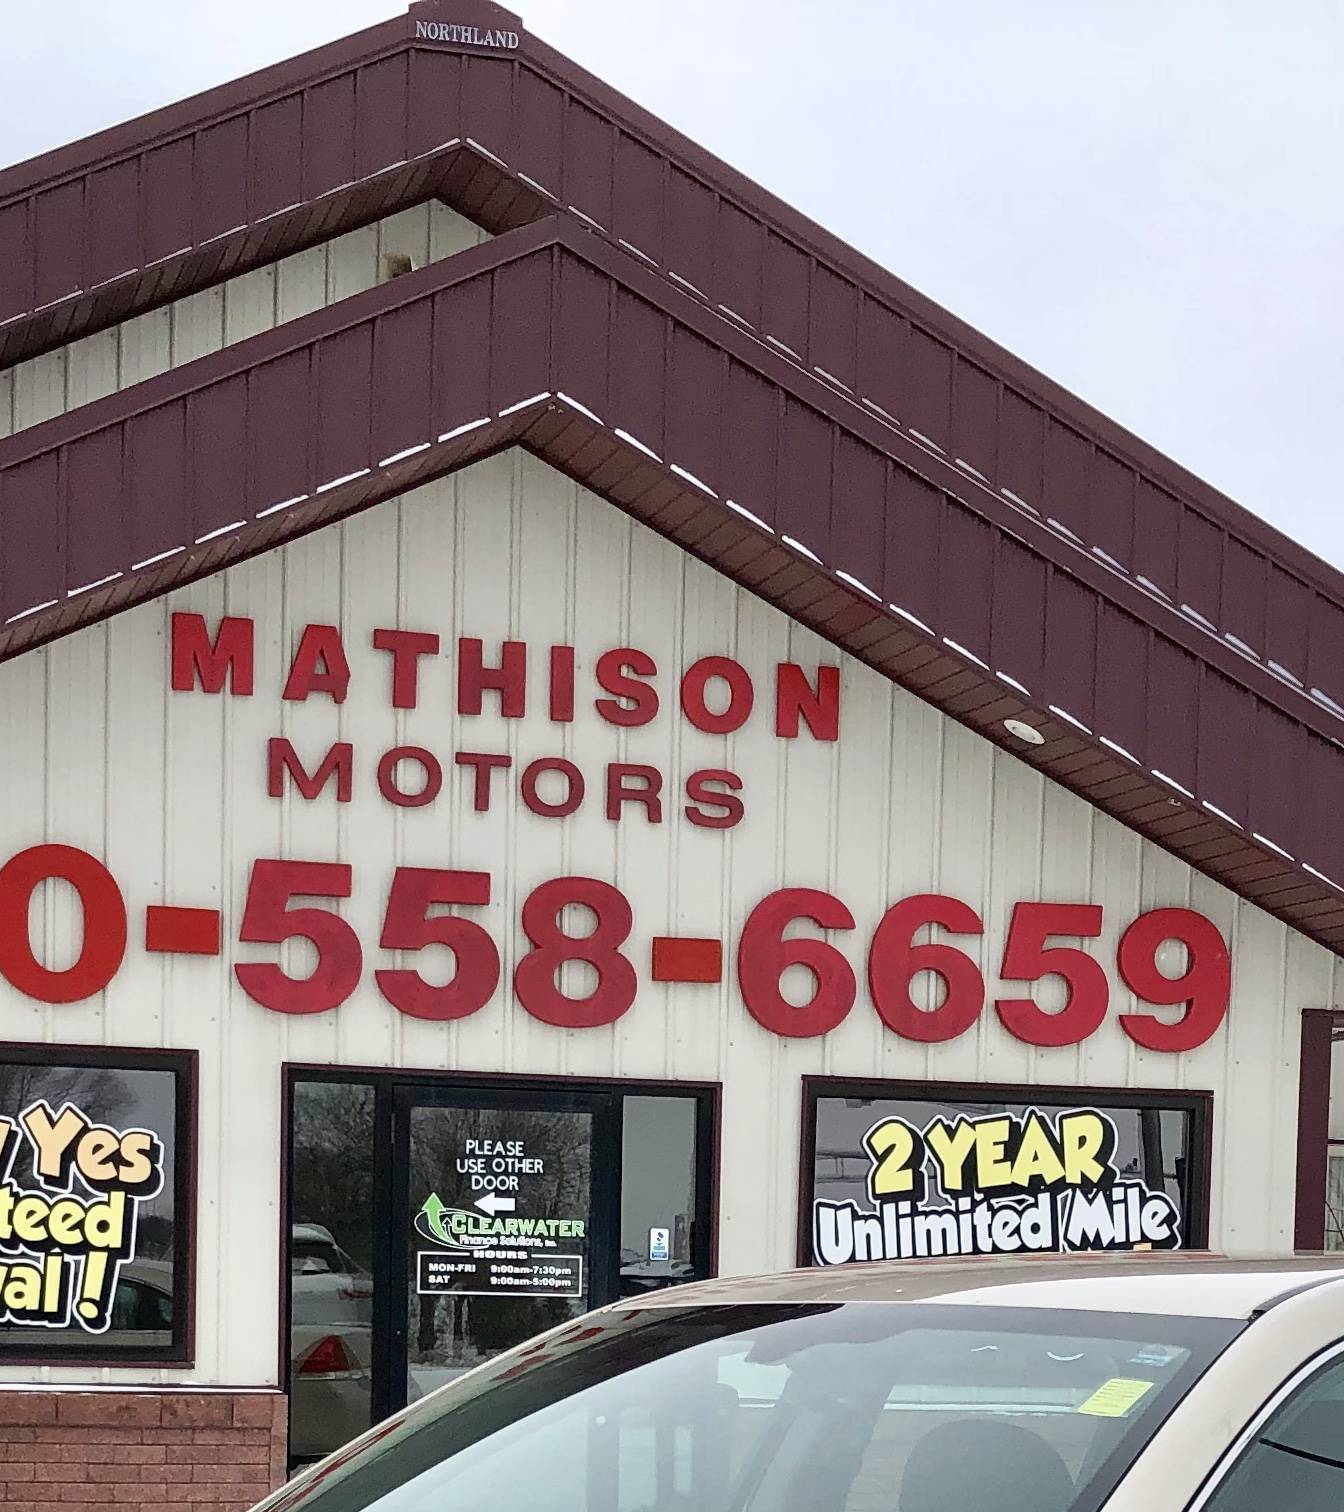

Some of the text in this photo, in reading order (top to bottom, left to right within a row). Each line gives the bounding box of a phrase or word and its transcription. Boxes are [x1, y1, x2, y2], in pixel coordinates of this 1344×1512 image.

[415, 20, 520, 49] NORTHLAND
[171, 611, 841, 742] MATHISON
[267, 737, 745, 829] MOTORS
[23, 1104, 153, 1183] Yes
[465, 1139, 525, 1156] PLEASE
[869, 1113, 1106, 1194] 2 YEAR
[456, 1158, 544, 1174] USE OTHER
[471, 1175, 519, 1190] DOOR
[451, 1214, 585, 1238] CLEARWATER
[818, 1186, 1172, 1265] Unlimited Mile
[472, 1250, 528, 1259] HOURS
[428, 1263, 476, 1273] MON-FRI
[428, 1275, 451, 1284] SAT
